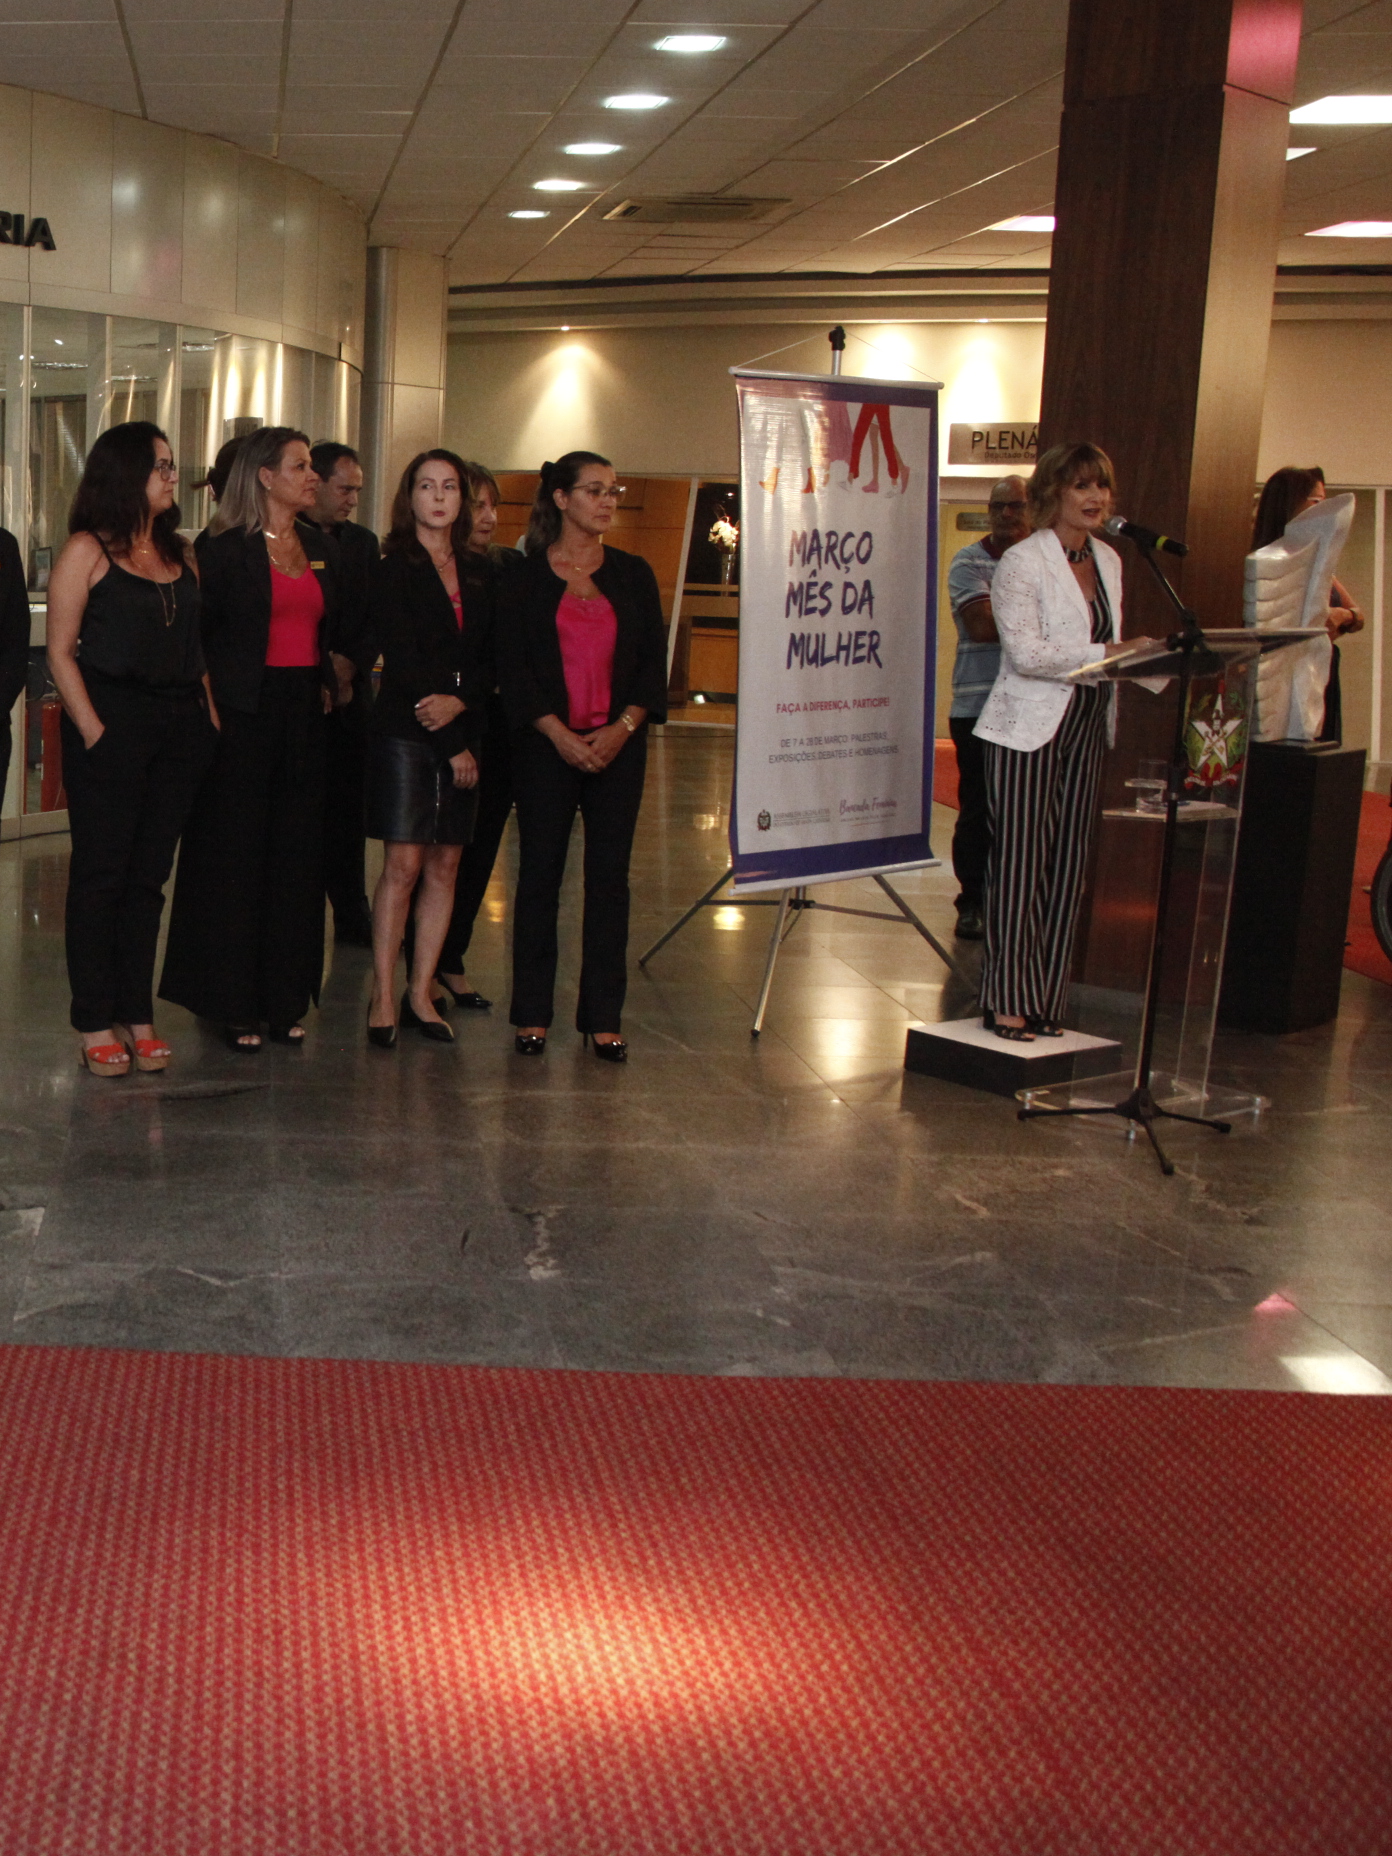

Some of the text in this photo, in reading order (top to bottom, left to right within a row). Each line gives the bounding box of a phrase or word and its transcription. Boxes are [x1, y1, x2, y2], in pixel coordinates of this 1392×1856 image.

[971, 425, 1038, 450] PLENÁ
[788, 528, 873, 574] MARÇO
[785, 569, 875, 619] MÊS DA
[786, 630, 883, 670] MULHER
[776, 702, 801, 715] FAÇA
[803, 701, 808, 712] A
[780, 738, 791, 748] DE
[793, 737, 798, 748] 7
[799, 737, 804, 747] A
[815, 736, 823, 746] DE
